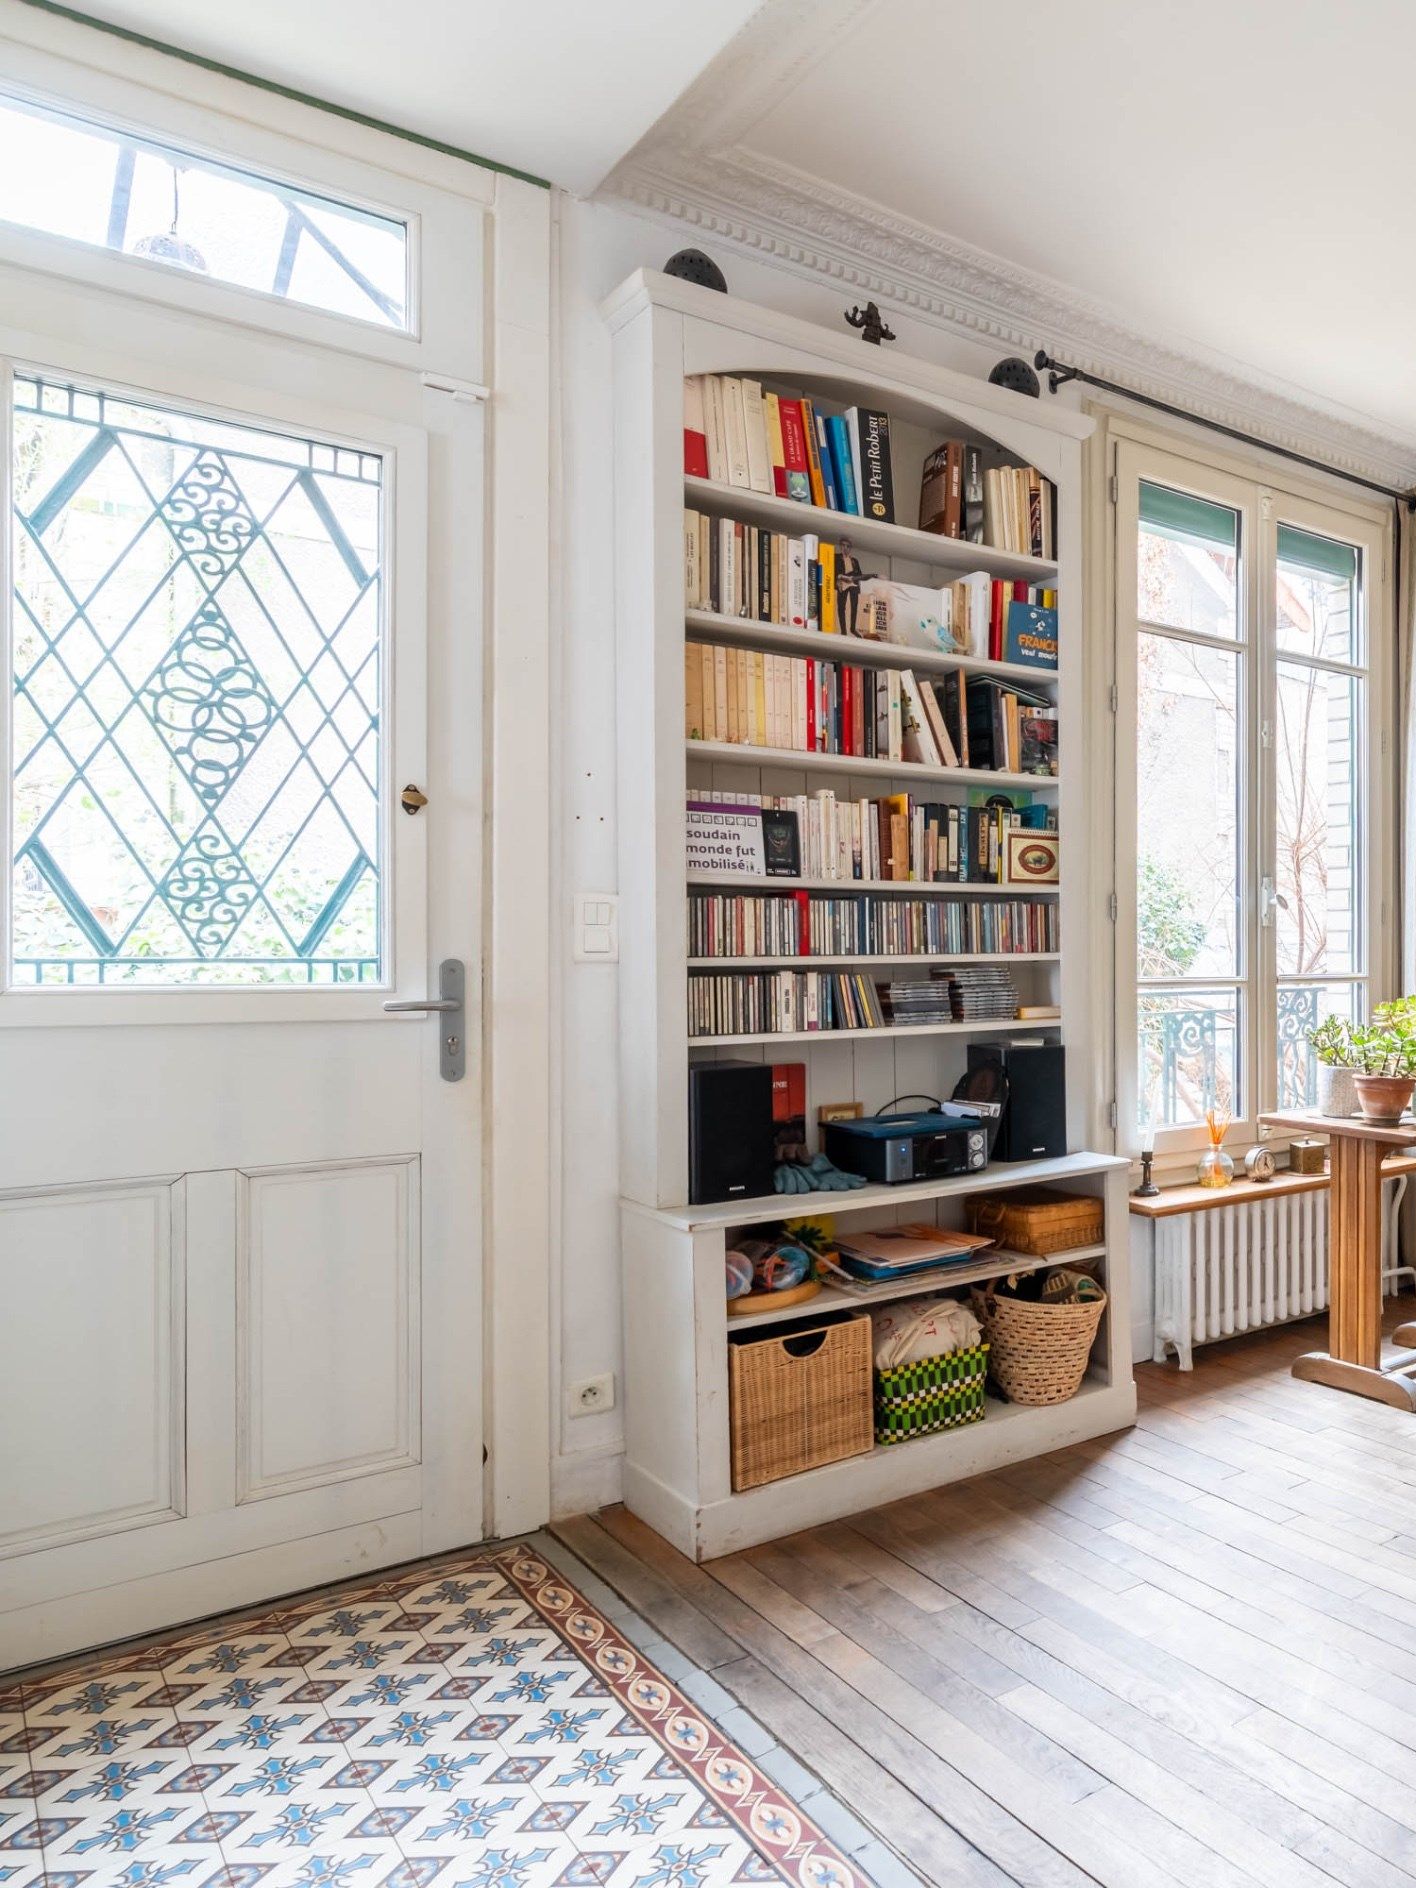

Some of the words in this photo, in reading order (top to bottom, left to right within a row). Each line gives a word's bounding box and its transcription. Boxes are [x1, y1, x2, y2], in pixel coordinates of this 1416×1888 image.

[878, 417, 888, 436] 2013
[686, 830, 741, 841] soudain
[686, 844, 733, 855] monde
[736, 846, 756, 857] fut
